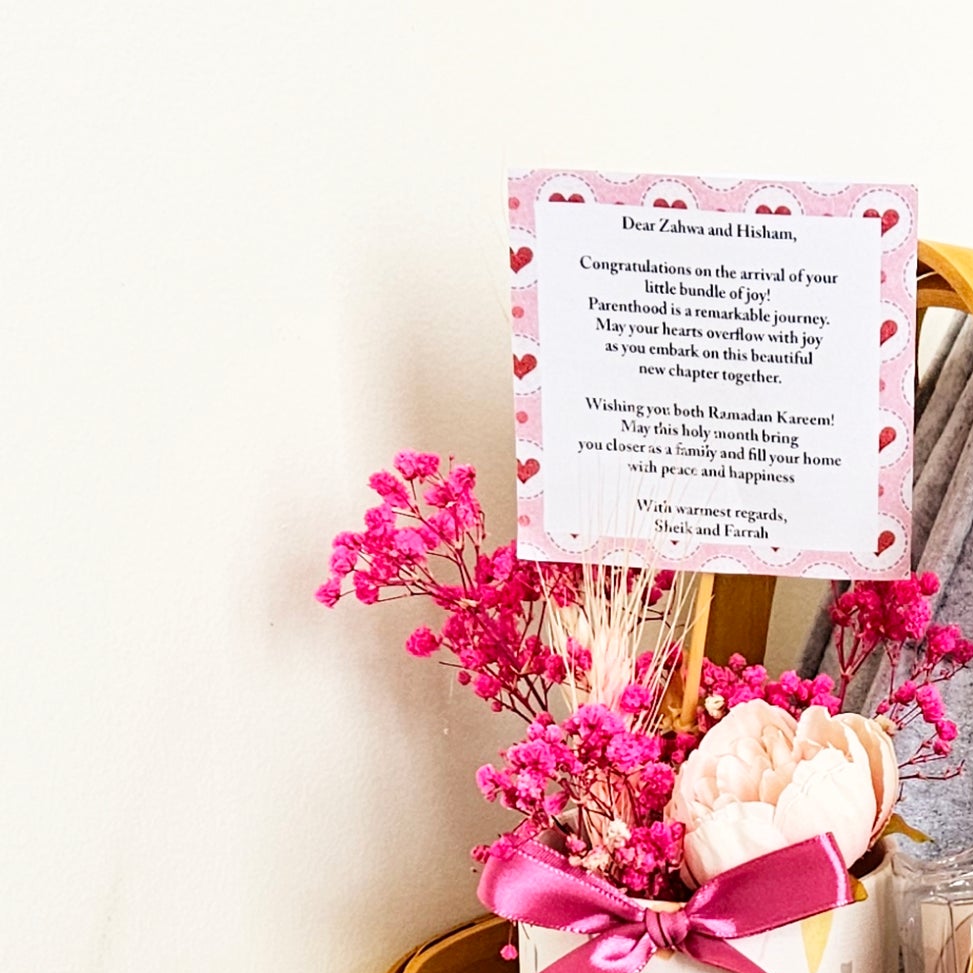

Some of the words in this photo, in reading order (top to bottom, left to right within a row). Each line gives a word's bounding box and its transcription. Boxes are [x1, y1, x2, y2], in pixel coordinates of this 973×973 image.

[622, 216, 655, 231] Dear
[659, 219, 704, 235] Zahwa
[708, 224, 732, 237] and
[737, 225, 797, 242] Hisham,
[580, 256, 691, 275] Congratulations
[695, 266, 712, 277] on
[715, 265, 736, 279] the
[740, 268, 784, 282] arrival
[789, 269, 805, 282] of
[806, 273, 838, 286] your
[645, 280, 676, 295] little
[679, 284, 725, 298] bundle
[729, 286, 744, 300] of
[745, 289, 770, 304] joy!
[589, 297, 666, 314] Parenthood
[671, 303, 681, 316] is
[685, 307, 691, 316] a
[695, 305, 770, 323] remarkable
[772, 310, 829, 328] journey.
[596, 318, 626, 335] May
[629, 324, 659, 339] your
[662, 323, 703, 337] hearts
[707, 328, 764, 342] overflow
[768, 331, 798, 344] with
[801, 333, 823, 349] joy
[605, 342, 618, 351] as
[621, 344, 645, 356] you
[649, 342, 699, 358] embark
[702, 349, 719, 359] on
[723, 348, 747, 361] this
[751, 349, 813, 365] beautiful
[639, 365, 665, 375] new
[669, 365, 719, 382] chapter
[722, 371, 782, 385] together.
[585, 397, 644, 417] Wishing
[647, 404, 670, 417] you
[674, 403, 704, 418] both
[708, 406, 772, 423] Ramadan
[777, 411, 835, 426] Kareem!
[621, 420, 652, 436] May
[654, 422, 678, 435] this
[682, 424, 709, 441] holy
[714, 429, 759, 442] month
[762, 433, 799, 448] bring
[578, 441, 602, 453] you
[606, 439, 645, 453] closer
[648, 445, 661, 454] as
[666, 447, 672, 455] a
[720, 448, 745, 460] and
[748, 448, 766, 461] fill
[769, 453, 799, 466] your
[803, 451, 842, 466] home
[701, 465, 725, 478] and
[729, 466, 795, 485] happiness
[636, 499, 672, 513] With
[676, 503, 730, 518] warmest
[735, 507, 787, 523] regards,
[655, 520, 691, 534] Sheik
[695, 522, 721, 536] and
[725, 524, 769, 539] Farrah
